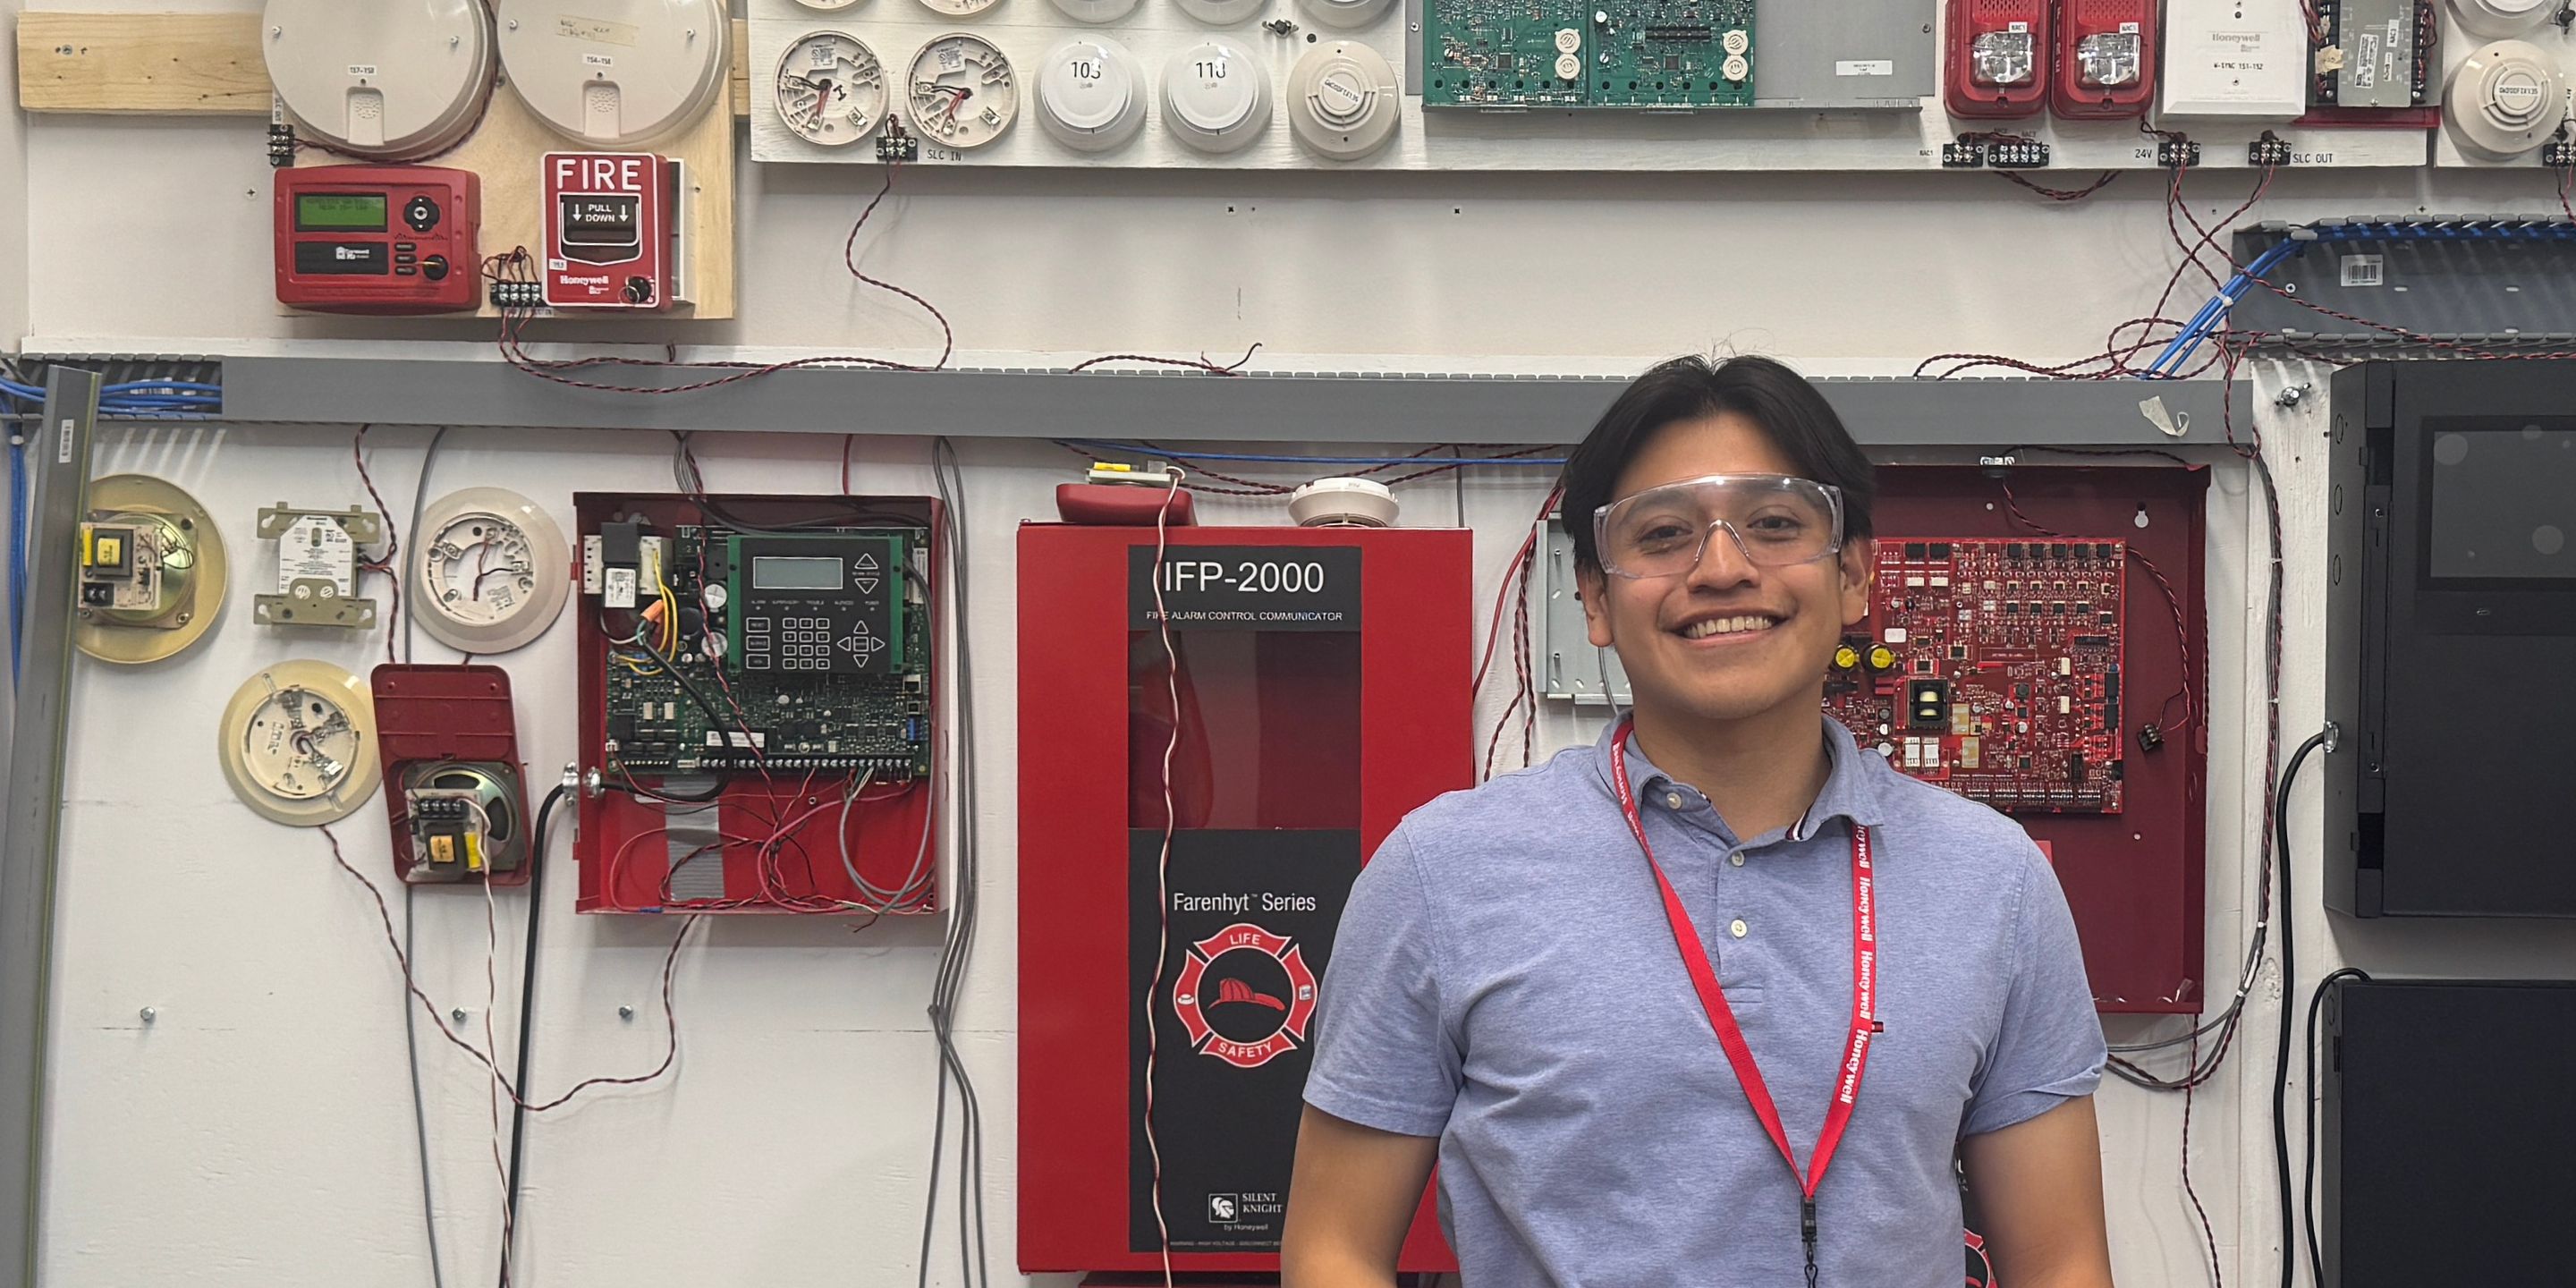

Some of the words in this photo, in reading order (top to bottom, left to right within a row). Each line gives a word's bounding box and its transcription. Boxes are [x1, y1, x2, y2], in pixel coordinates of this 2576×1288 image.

[2212, 33, 2260, 43] Honeywell
[1071, 62, 1101, 79] 103
[927, 149, 945, 159] SLC
[951, 151, 962, 161] IN
[2135, 148, 2152, 158] 24V
[2292, 154, 2311, 164] SLC
[2316, 154, 2334, 164] OUT
[556, 158, 642, 191] FIRE
[589, 204, 612, 212] PULL
[585, 214, 615, 223] DOWN
[560, 275, 609, 286] Honeywell
[1165, 562, 1325, 592] IFP-2000
[1172, 611, 1207, 621] ALARM
[1208, 611, 1256, 621] CONTROL
[1259, 611, 1343, 621] COMMUNICATOR
[1261, 893, 1317, 911] Series
[1858, 877, 1873, 942] Honeywell
[1230, 933, 1261, 945] LIFE
[1859, 950, 1873, 1020] Honeywell
[1218, 1041, 1272, 1058] SAFETY
[1840, 1029, 1868, 1104] Honeywell
[1241, 1192, 1277, 1202] SILENT
[1242, 1203, 1283, 1213] KNIGHT
[1224, 1224, 1233, 1232] by
[1234, 1223, 1268, 1232] Honeywell
